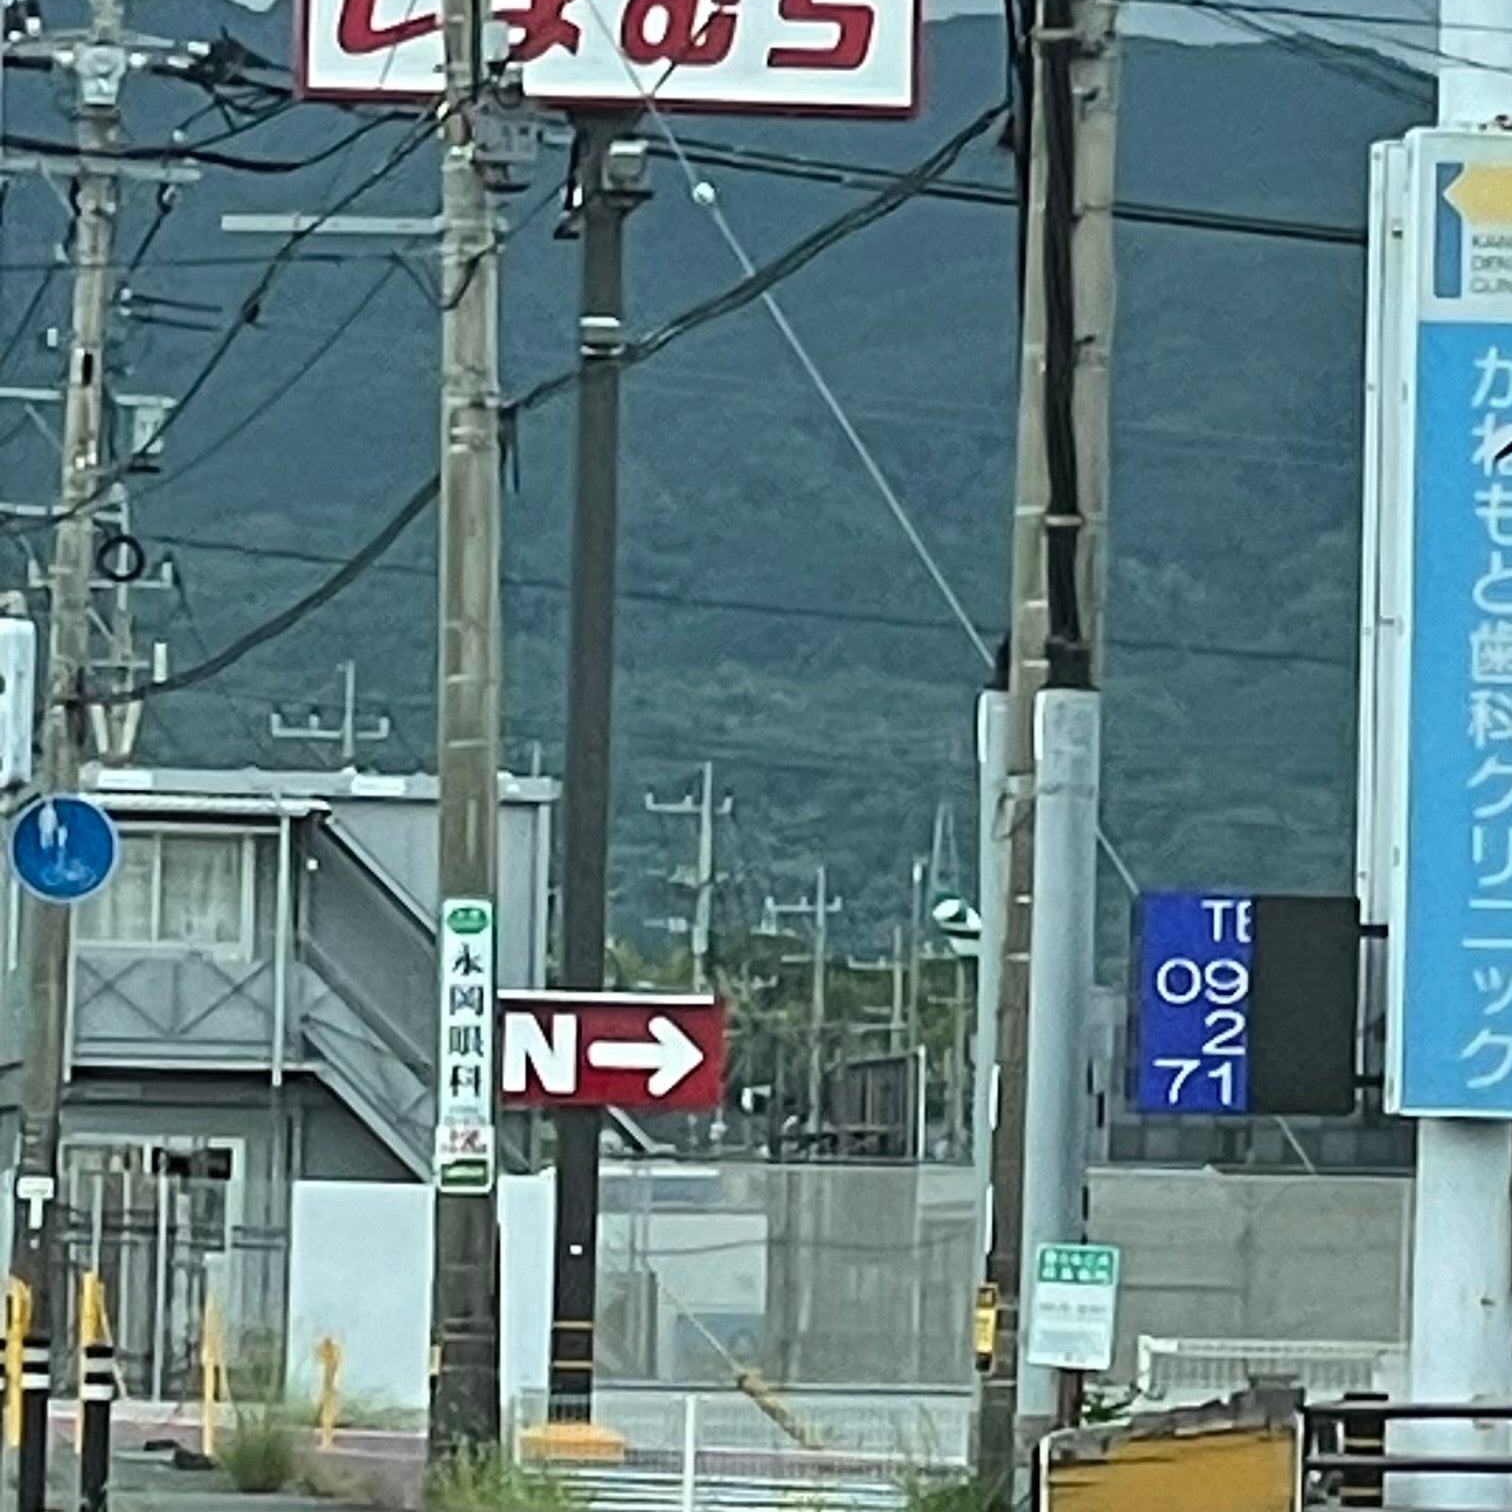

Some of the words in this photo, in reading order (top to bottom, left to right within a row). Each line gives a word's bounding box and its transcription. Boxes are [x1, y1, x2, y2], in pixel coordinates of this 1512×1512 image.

[1156, 957, 1249, 1004] 09
[449, 942, 484, 1097] 永岡眼科
[1202, 1009, 1245, 1055] 2
[1153, 1058, 1233, 1106] 71
